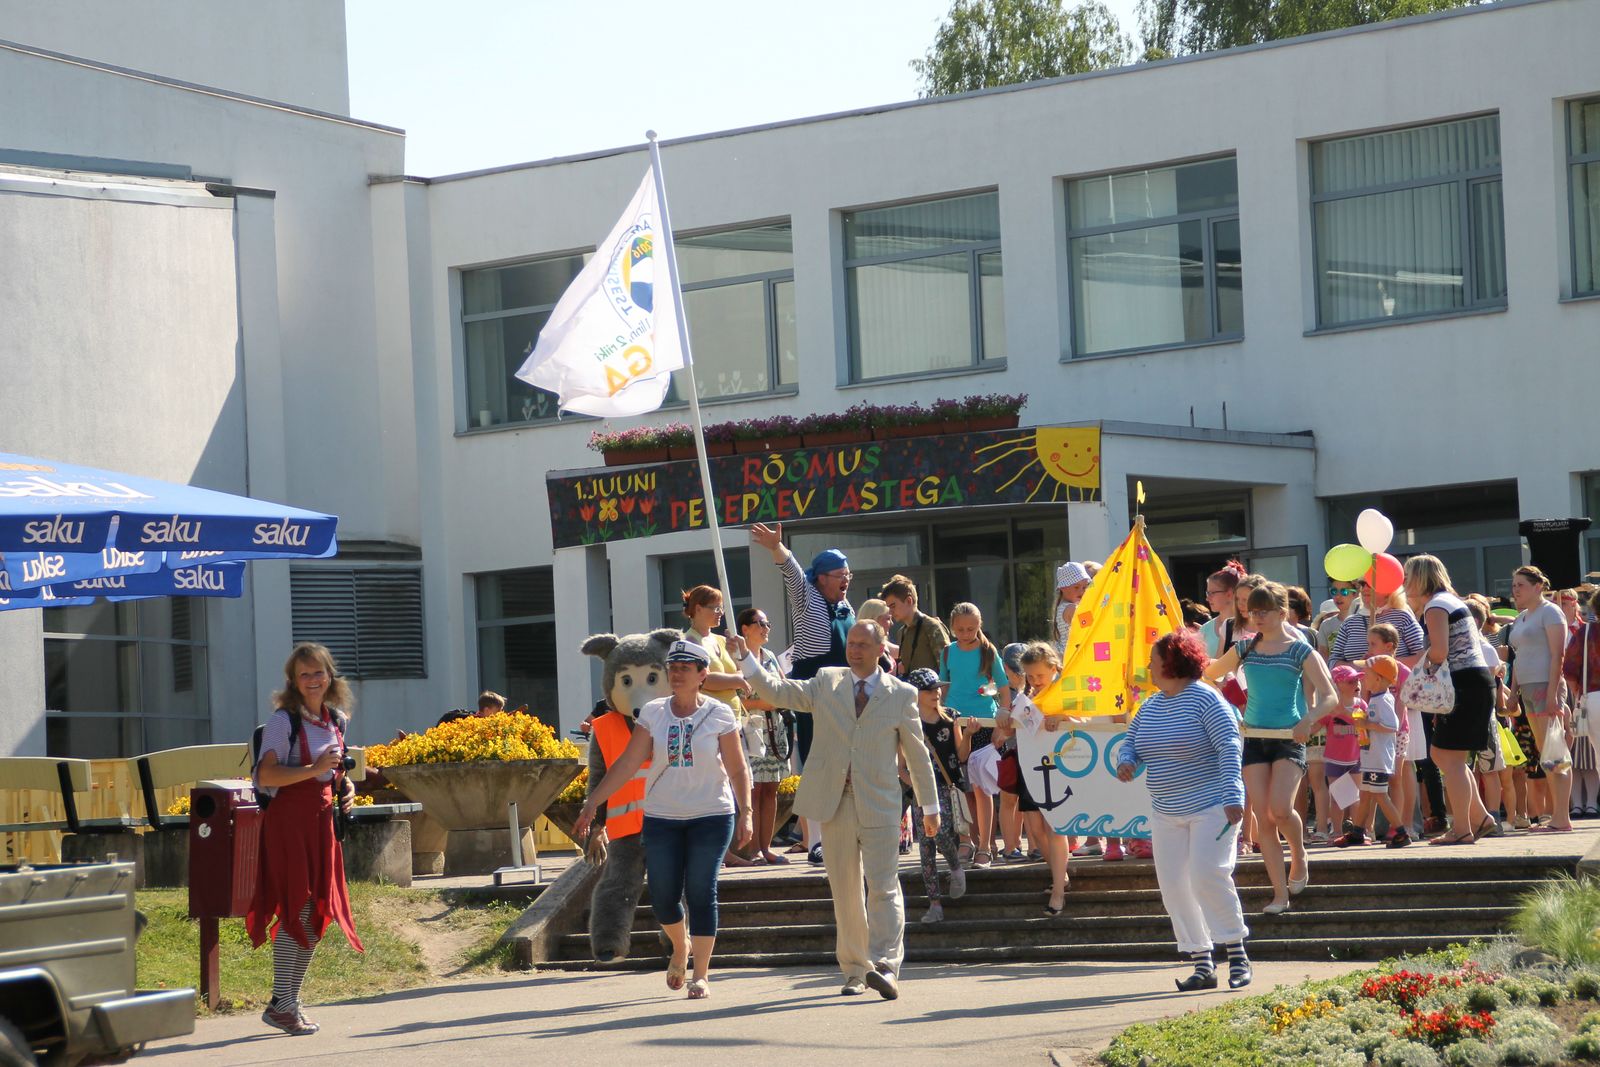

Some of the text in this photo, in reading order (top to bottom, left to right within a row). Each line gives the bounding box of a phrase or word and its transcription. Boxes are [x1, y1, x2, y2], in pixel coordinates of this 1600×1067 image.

[743, 446, 880, 486] RÕÕMUS
[671, 475, 963, 529] PEREPÄEV LASTEGA
[22, 513, 85, 544] saku
[140, 513, 202, 544] saku
[252, 517, 311, 546] saku
[174, 565, 225, 590] saku
